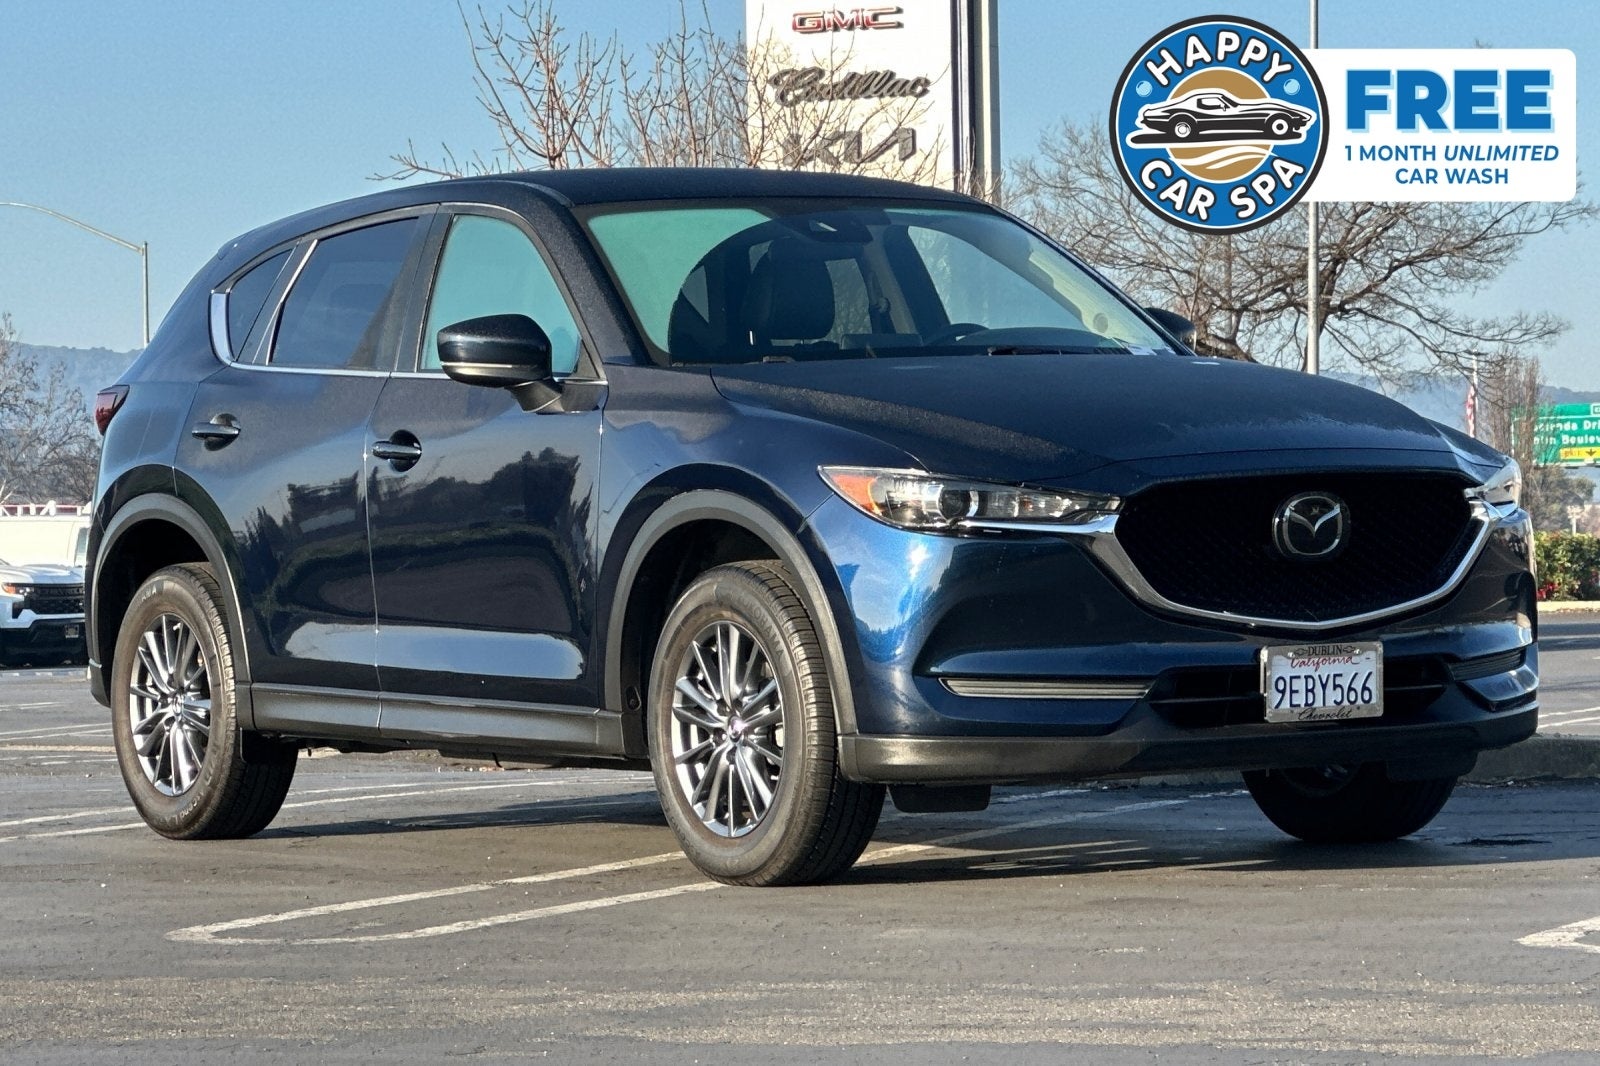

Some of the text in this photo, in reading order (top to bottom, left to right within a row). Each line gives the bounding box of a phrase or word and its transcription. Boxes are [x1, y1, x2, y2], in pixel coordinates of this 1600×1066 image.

[792, 6, 904, 34] GMC
[768, 66, 931, 107] Cadillac
[1307, 645, 1343, 657] DUBLIN
[1289, 656, 1360, 673] California
[1274, 671, 1374, 709] 9EBY566
[1298, 706, 1352, 720] Chevrolet
